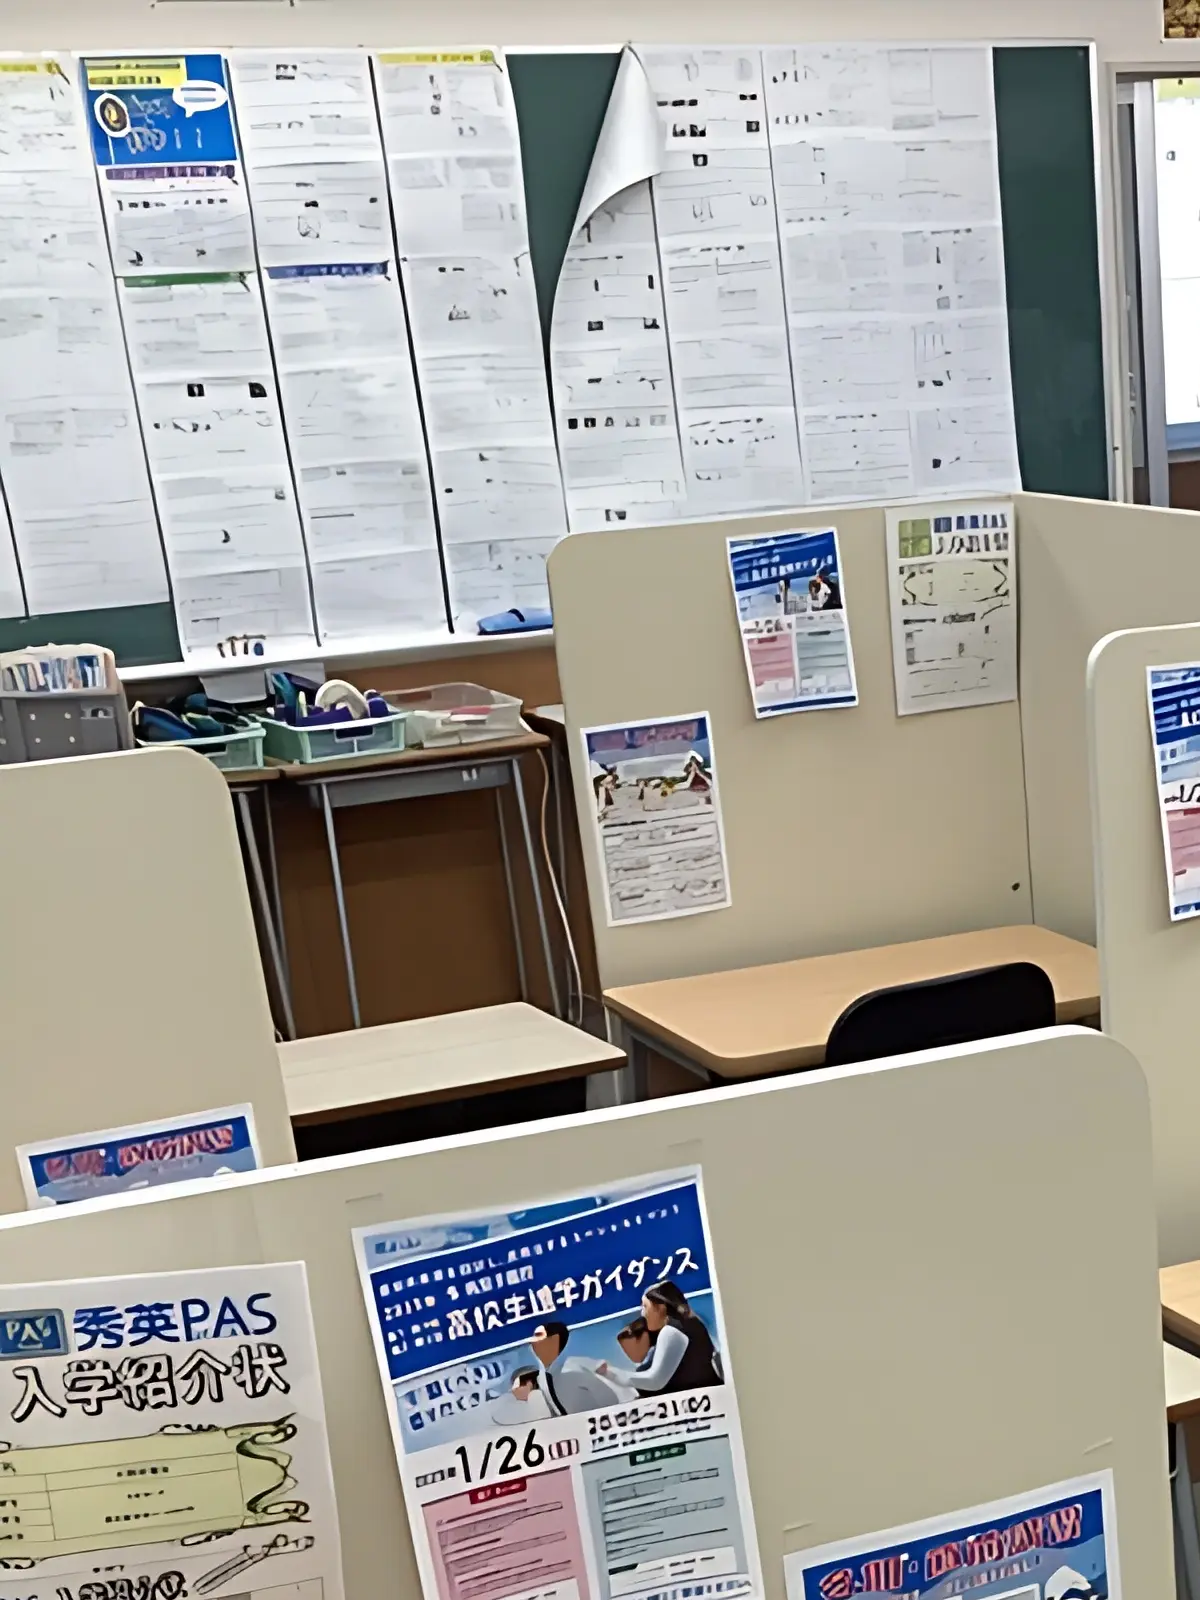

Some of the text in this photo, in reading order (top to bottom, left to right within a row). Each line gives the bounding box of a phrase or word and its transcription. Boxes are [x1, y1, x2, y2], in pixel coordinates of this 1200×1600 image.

[74, 1292, 278, 1352] 秀英PAS
[11, 1342, 292, 1424] 入学紹介状
[455, 1428, 546, 1483] 1/26
